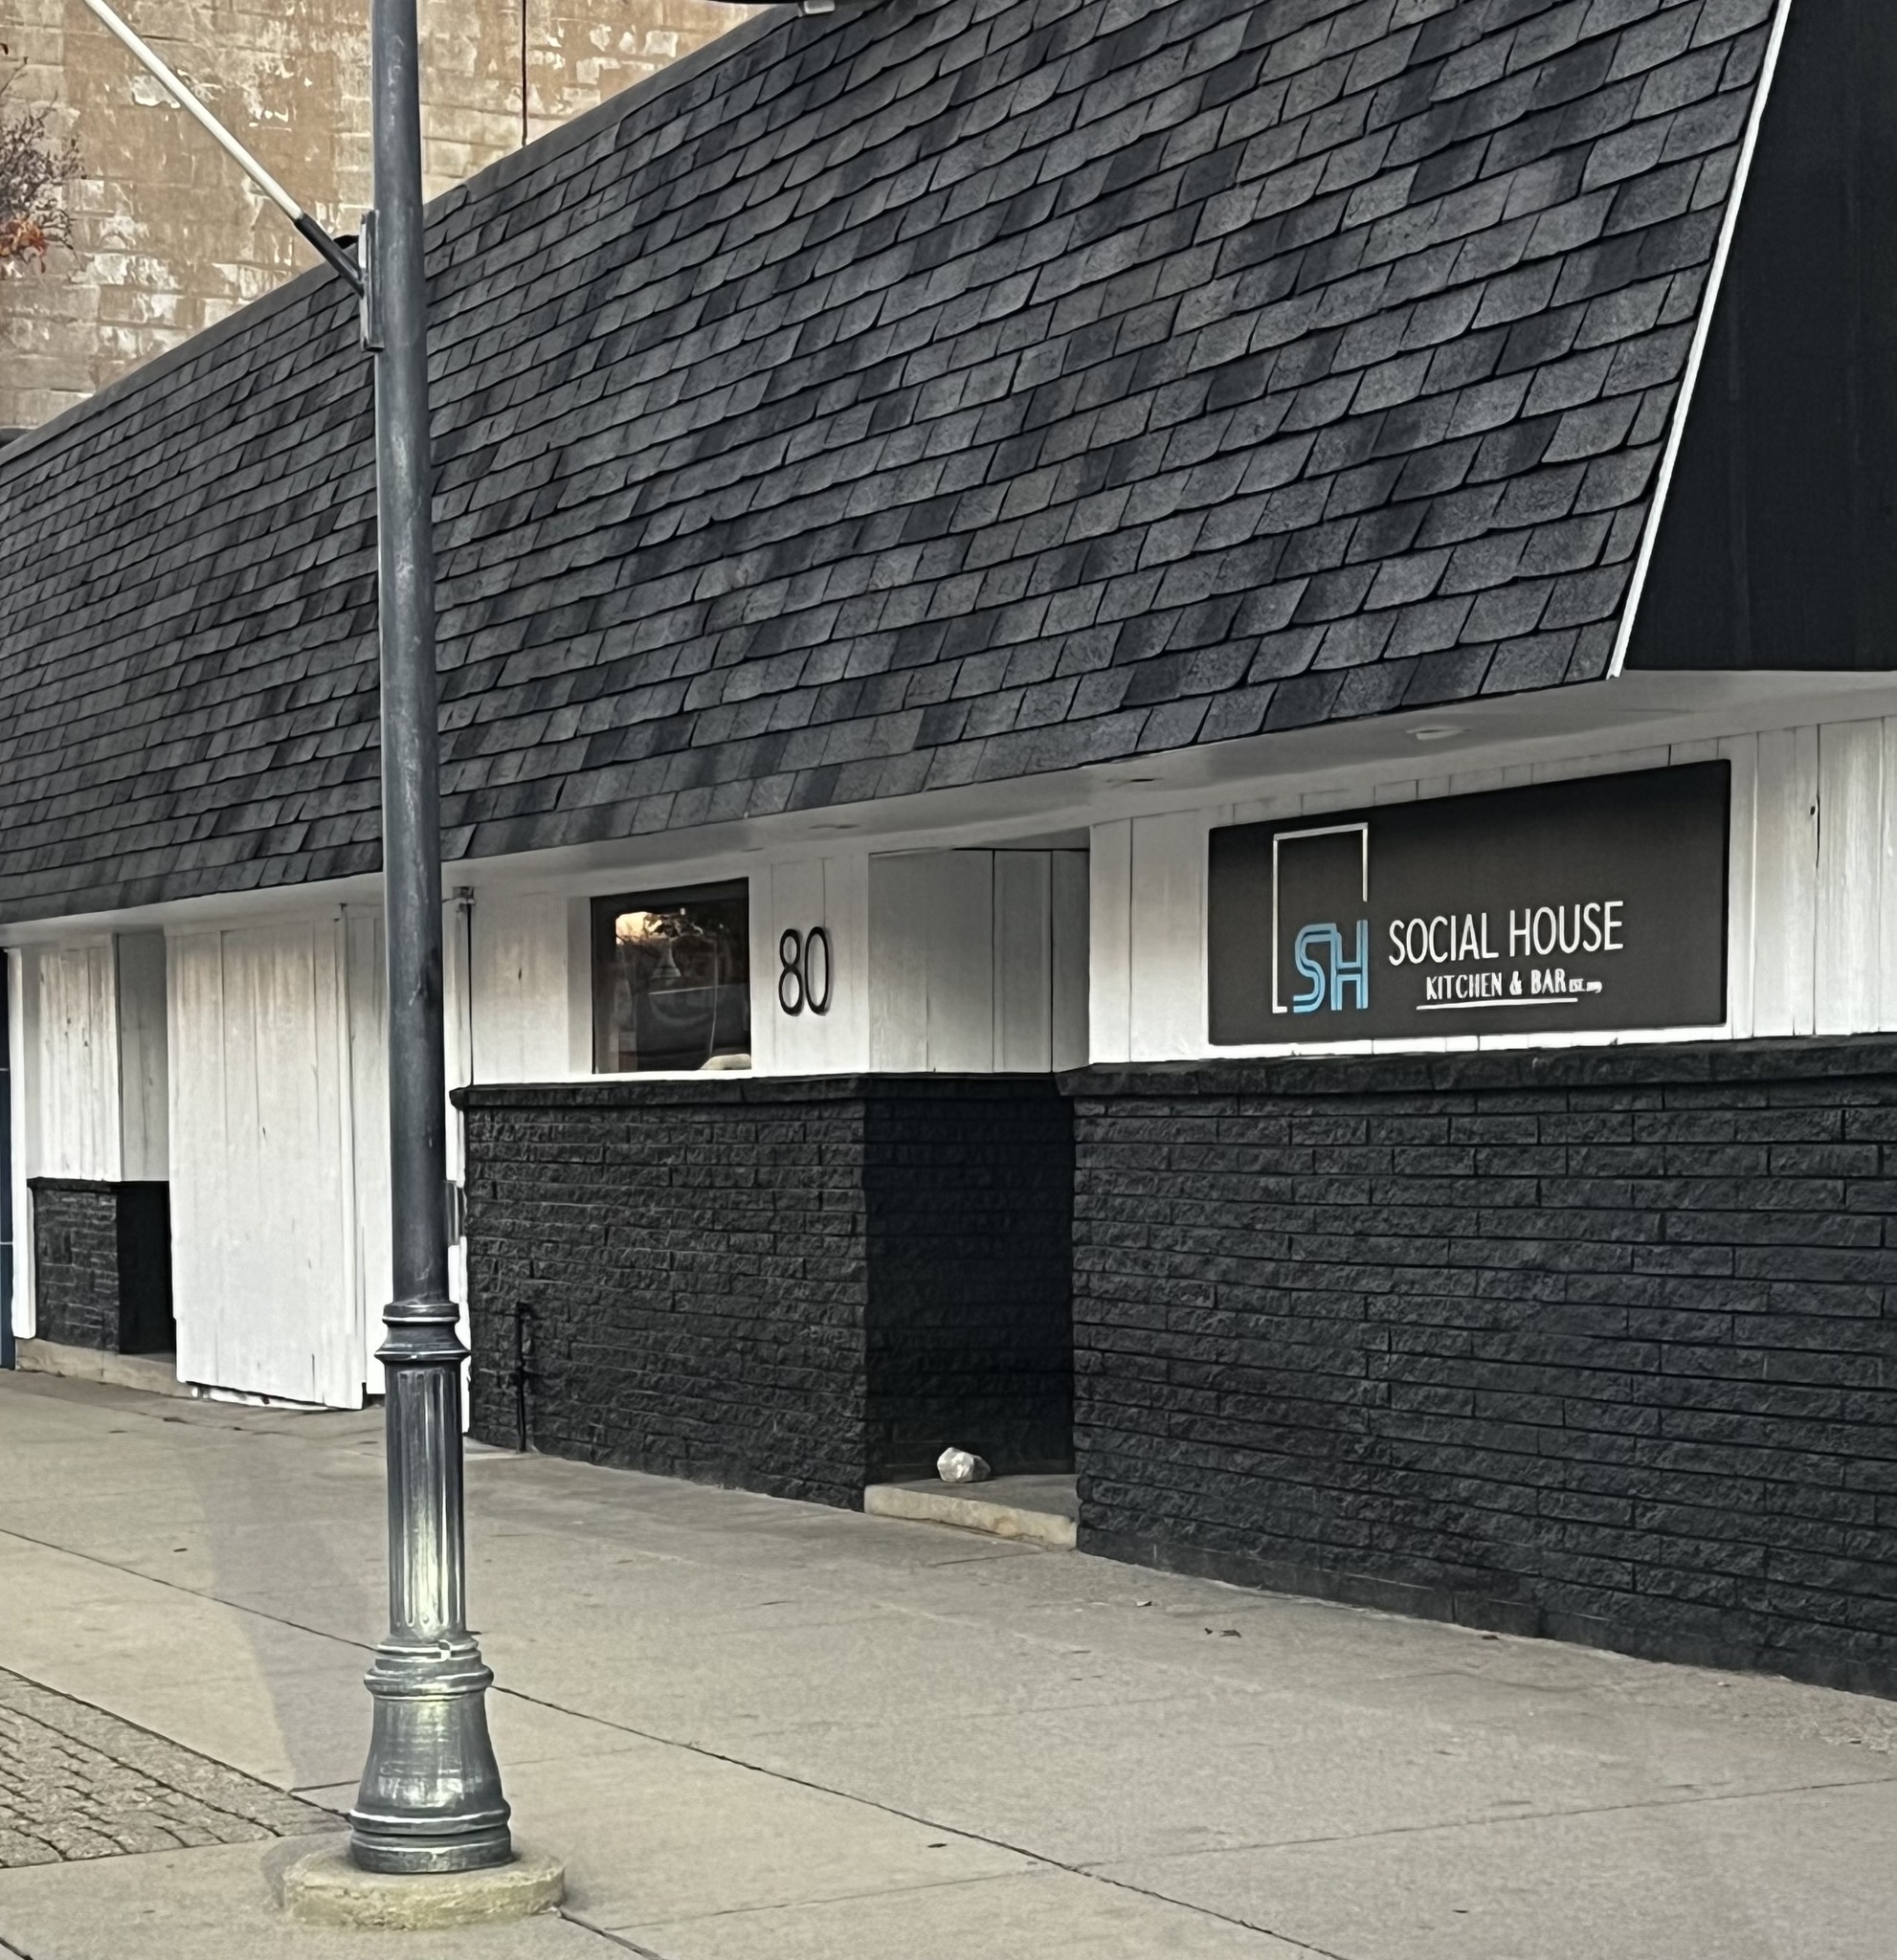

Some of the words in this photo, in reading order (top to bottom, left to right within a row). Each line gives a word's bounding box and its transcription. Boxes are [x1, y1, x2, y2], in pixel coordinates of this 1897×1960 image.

[778, 926, 831, 1016] 80
[1293, 920, 1369, 1013] SH
[1389, 913, 1500, 966] SOCIAL
[1509, 901, 1623, 957] HOUSE
[1426, 972, 1503, 1000] KITCHEN
[1509, 970, 1523, 995] &
[1531, 969, 1567, 994] BAR
